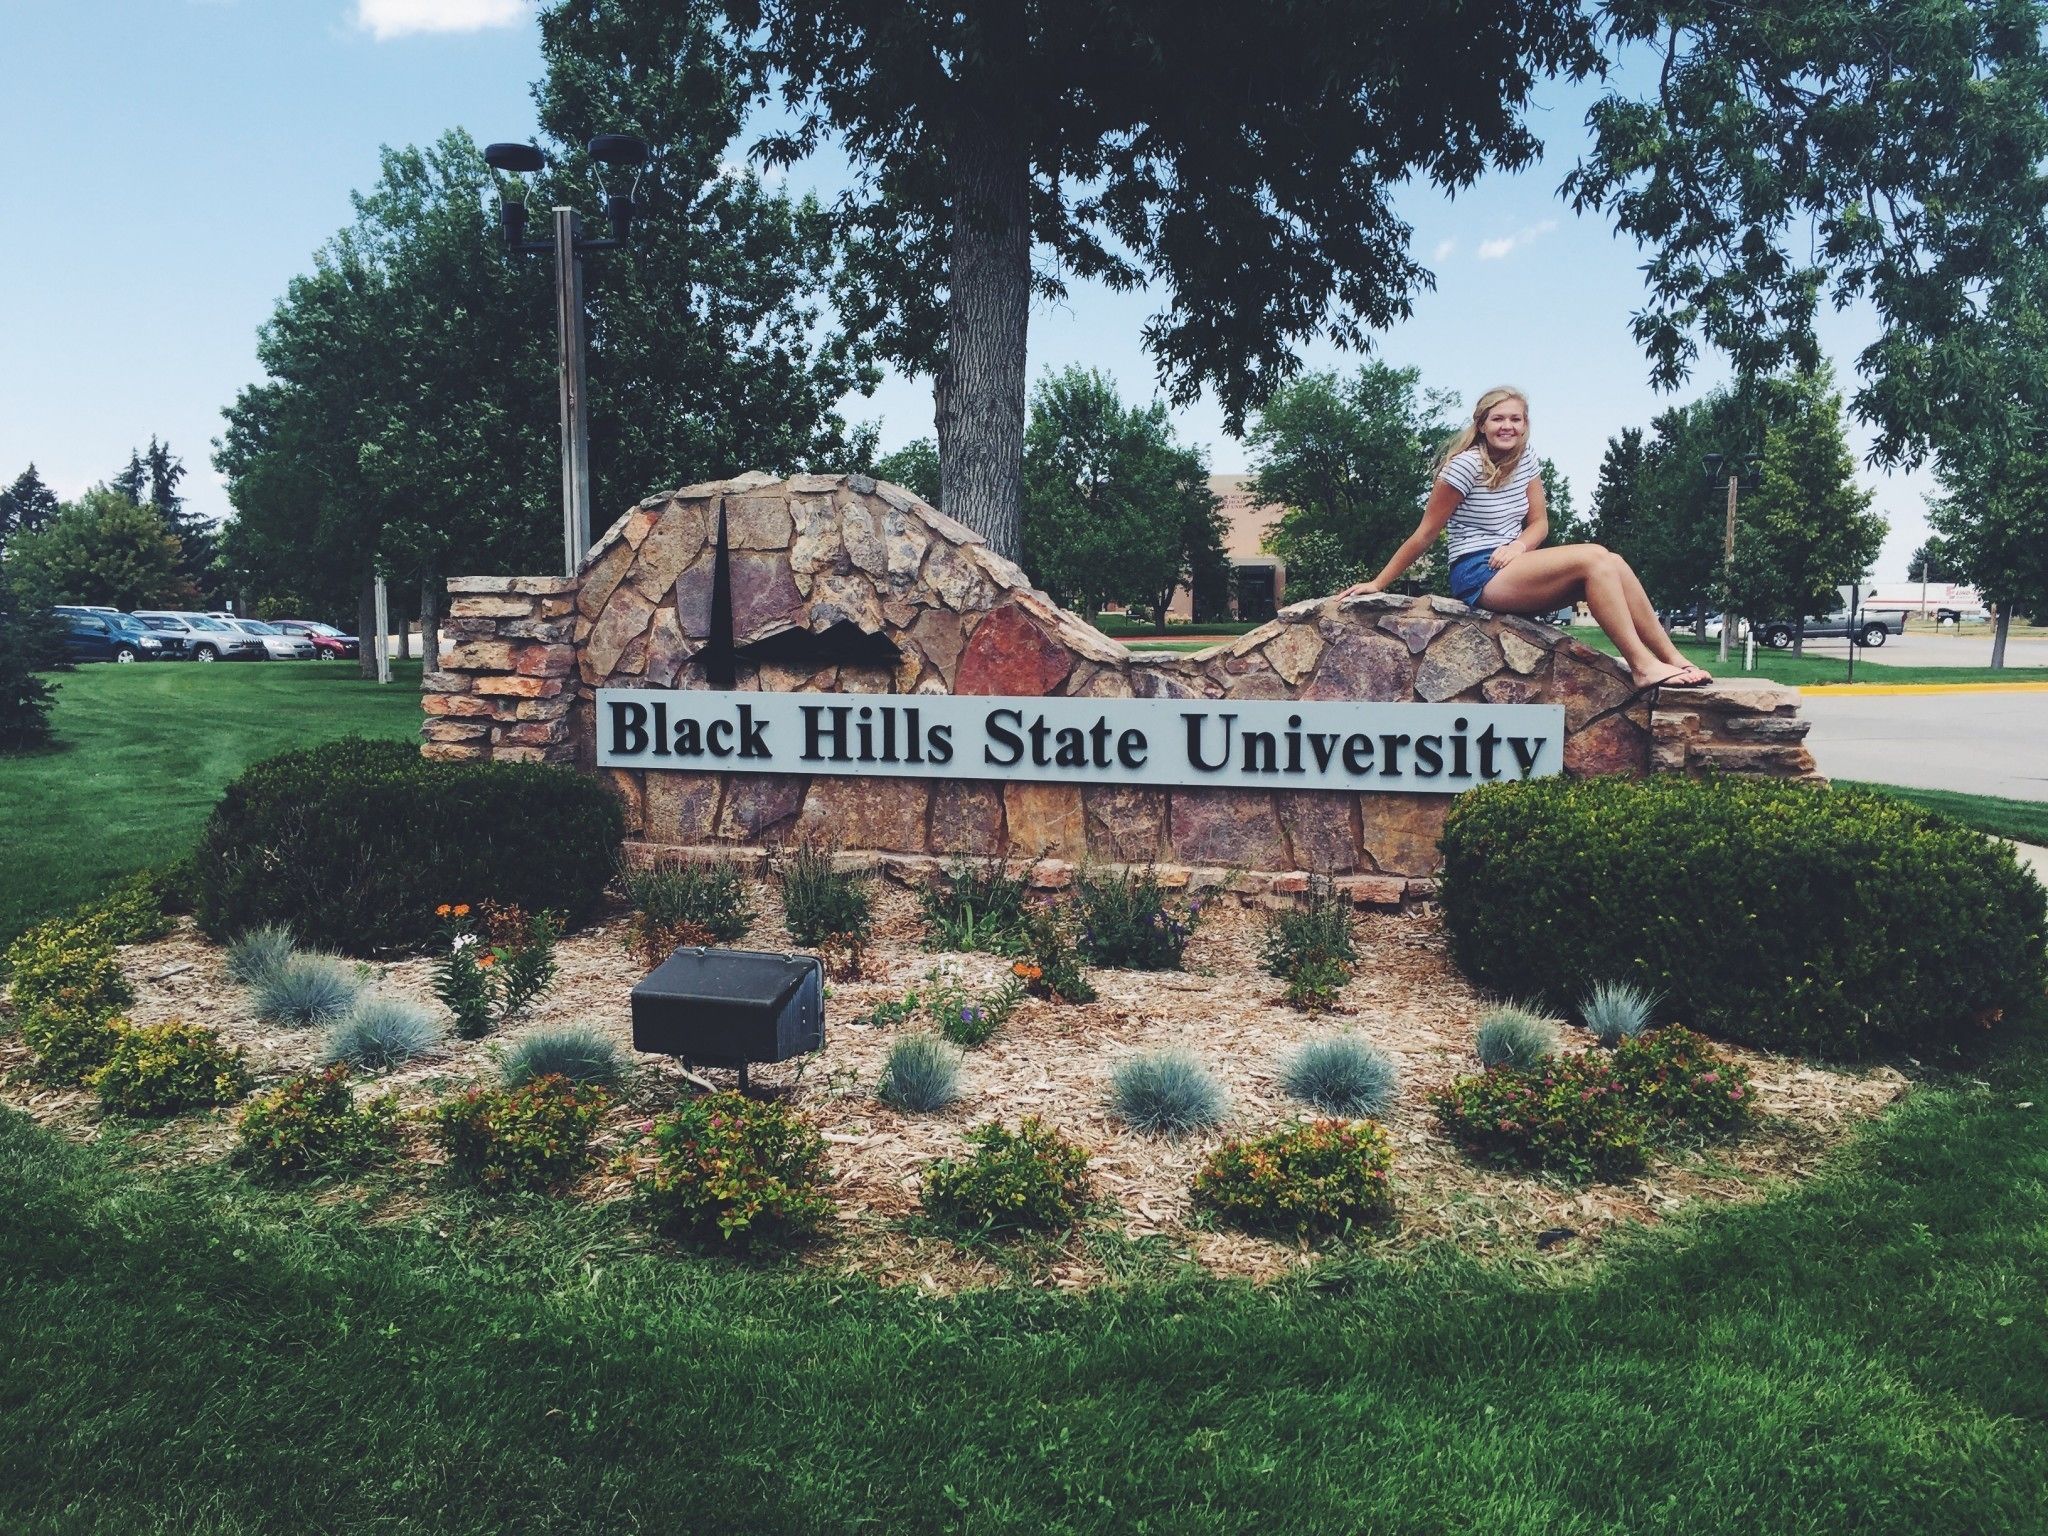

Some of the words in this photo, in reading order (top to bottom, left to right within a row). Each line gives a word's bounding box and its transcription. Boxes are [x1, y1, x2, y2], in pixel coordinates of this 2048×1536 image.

[606, 701, 773, 758] Black
[798, 705, 954, 765] Hills
[984, 708, 1148, 770] State
[1180, 713, 1547, 783] University
